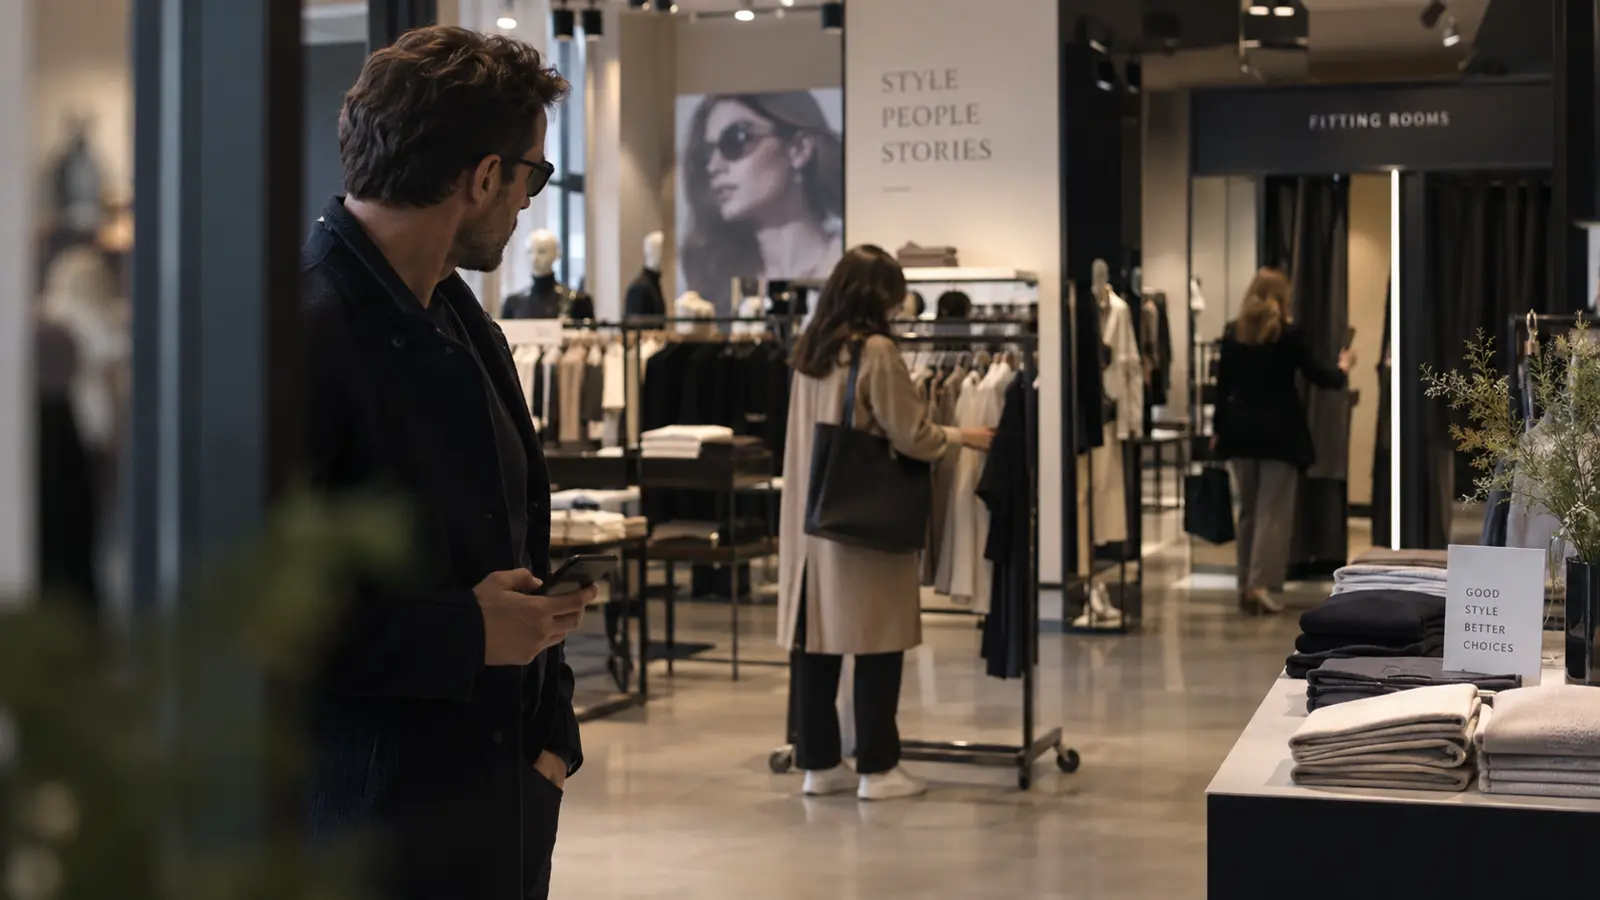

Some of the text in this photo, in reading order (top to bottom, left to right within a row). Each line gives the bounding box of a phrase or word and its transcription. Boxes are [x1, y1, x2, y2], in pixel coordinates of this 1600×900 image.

[881, 68, 959, 93] STYLE
[882, 102, 981, 128] PEOPLE
[1309, 110, 1450, 130] FITTING ROOMS
[881, 138, 992, 163] STORIES
[1465, 587, 1500, 599] GOOD
[1465, 604, 1498, 616] STYLE
[1464, 622, 1506, 634] BETTER
[1463, 640, 1514, 653] CHOICES
